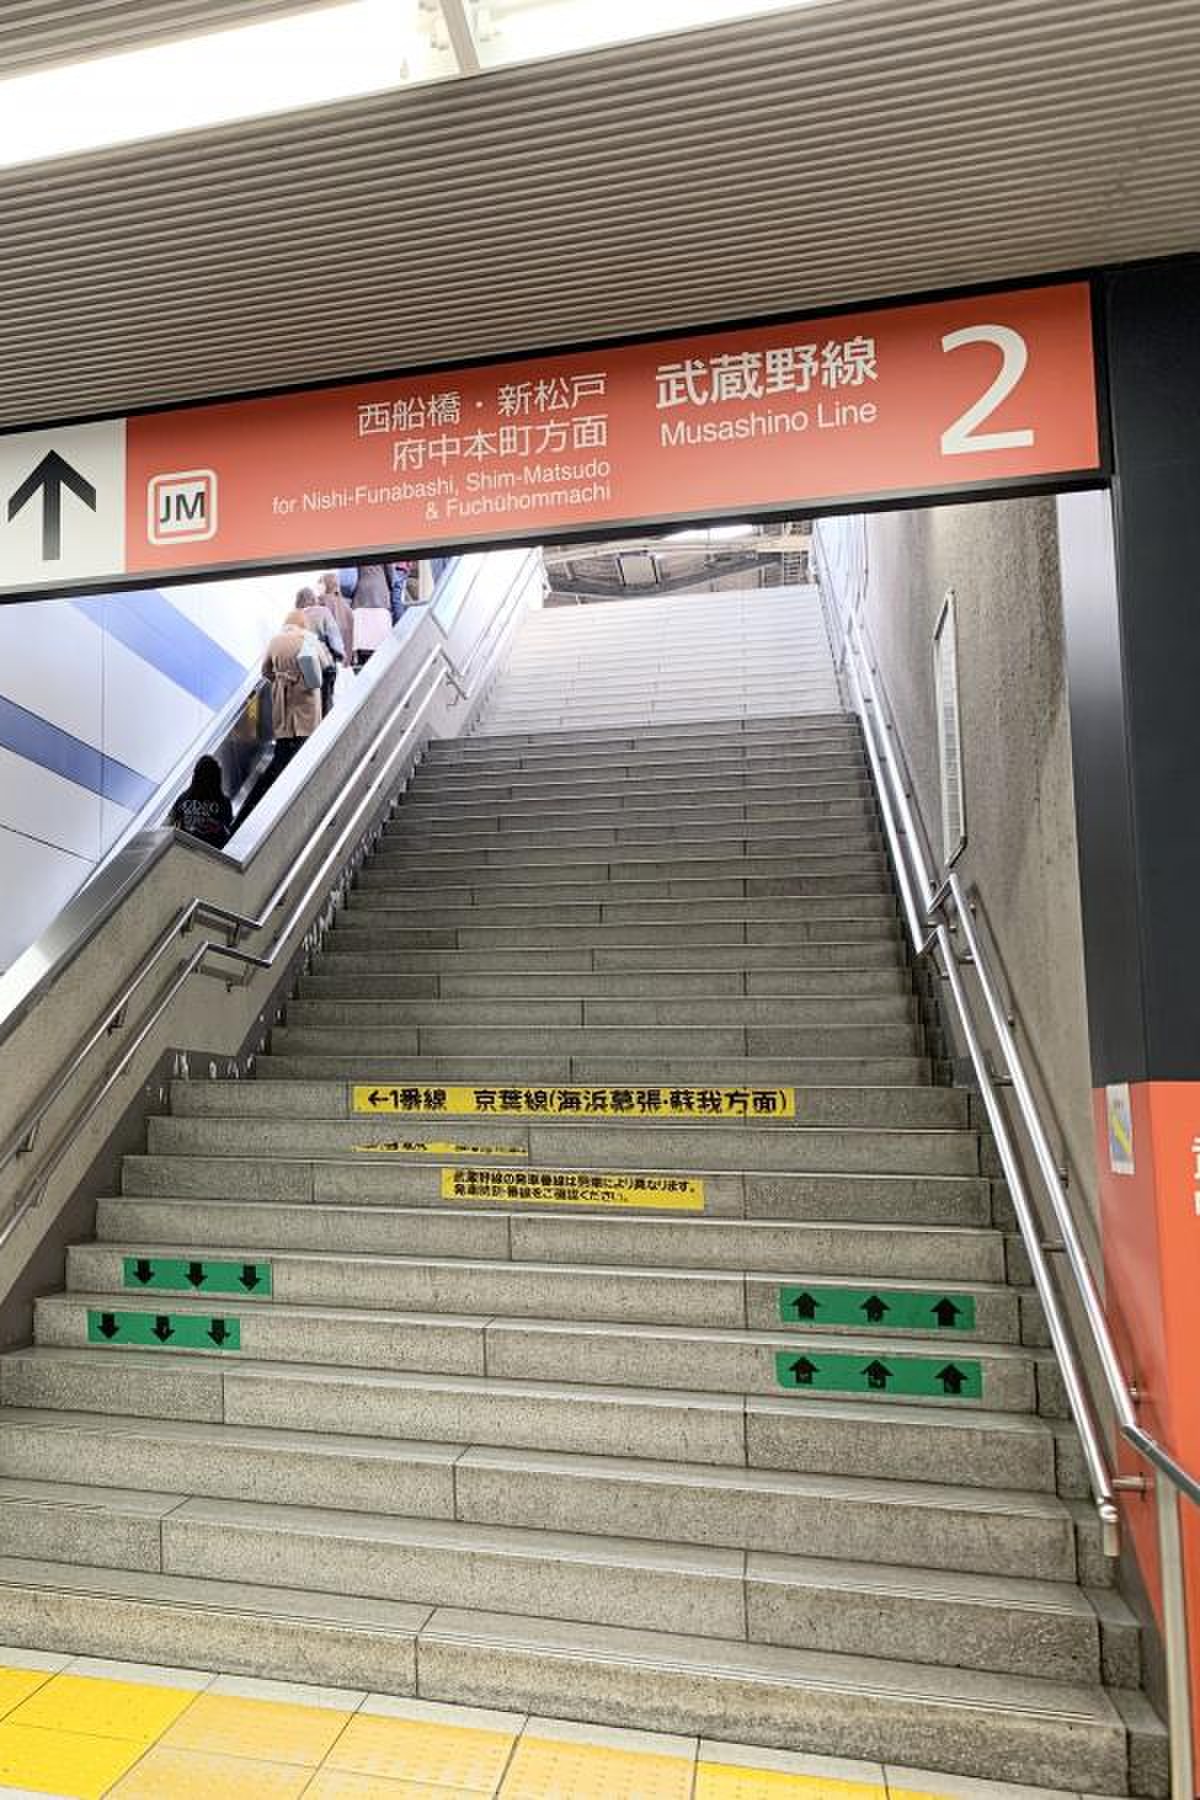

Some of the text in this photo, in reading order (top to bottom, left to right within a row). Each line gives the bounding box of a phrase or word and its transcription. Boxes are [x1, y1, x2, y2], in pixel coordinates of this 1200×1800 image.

[655, 334, 879, 410] 武蔵野線
[941, 323, 1035, 456] 2
[393, 414, 608, 473] 府中本町方面
[660, 400, 878, 448] Musashino Line
[159, 491, 206, 523] JM
[272, 497, 297, 515] for
[302, 476, 459, 513] Nishi-Funabashi,
[425, 503, 439, 521] &
